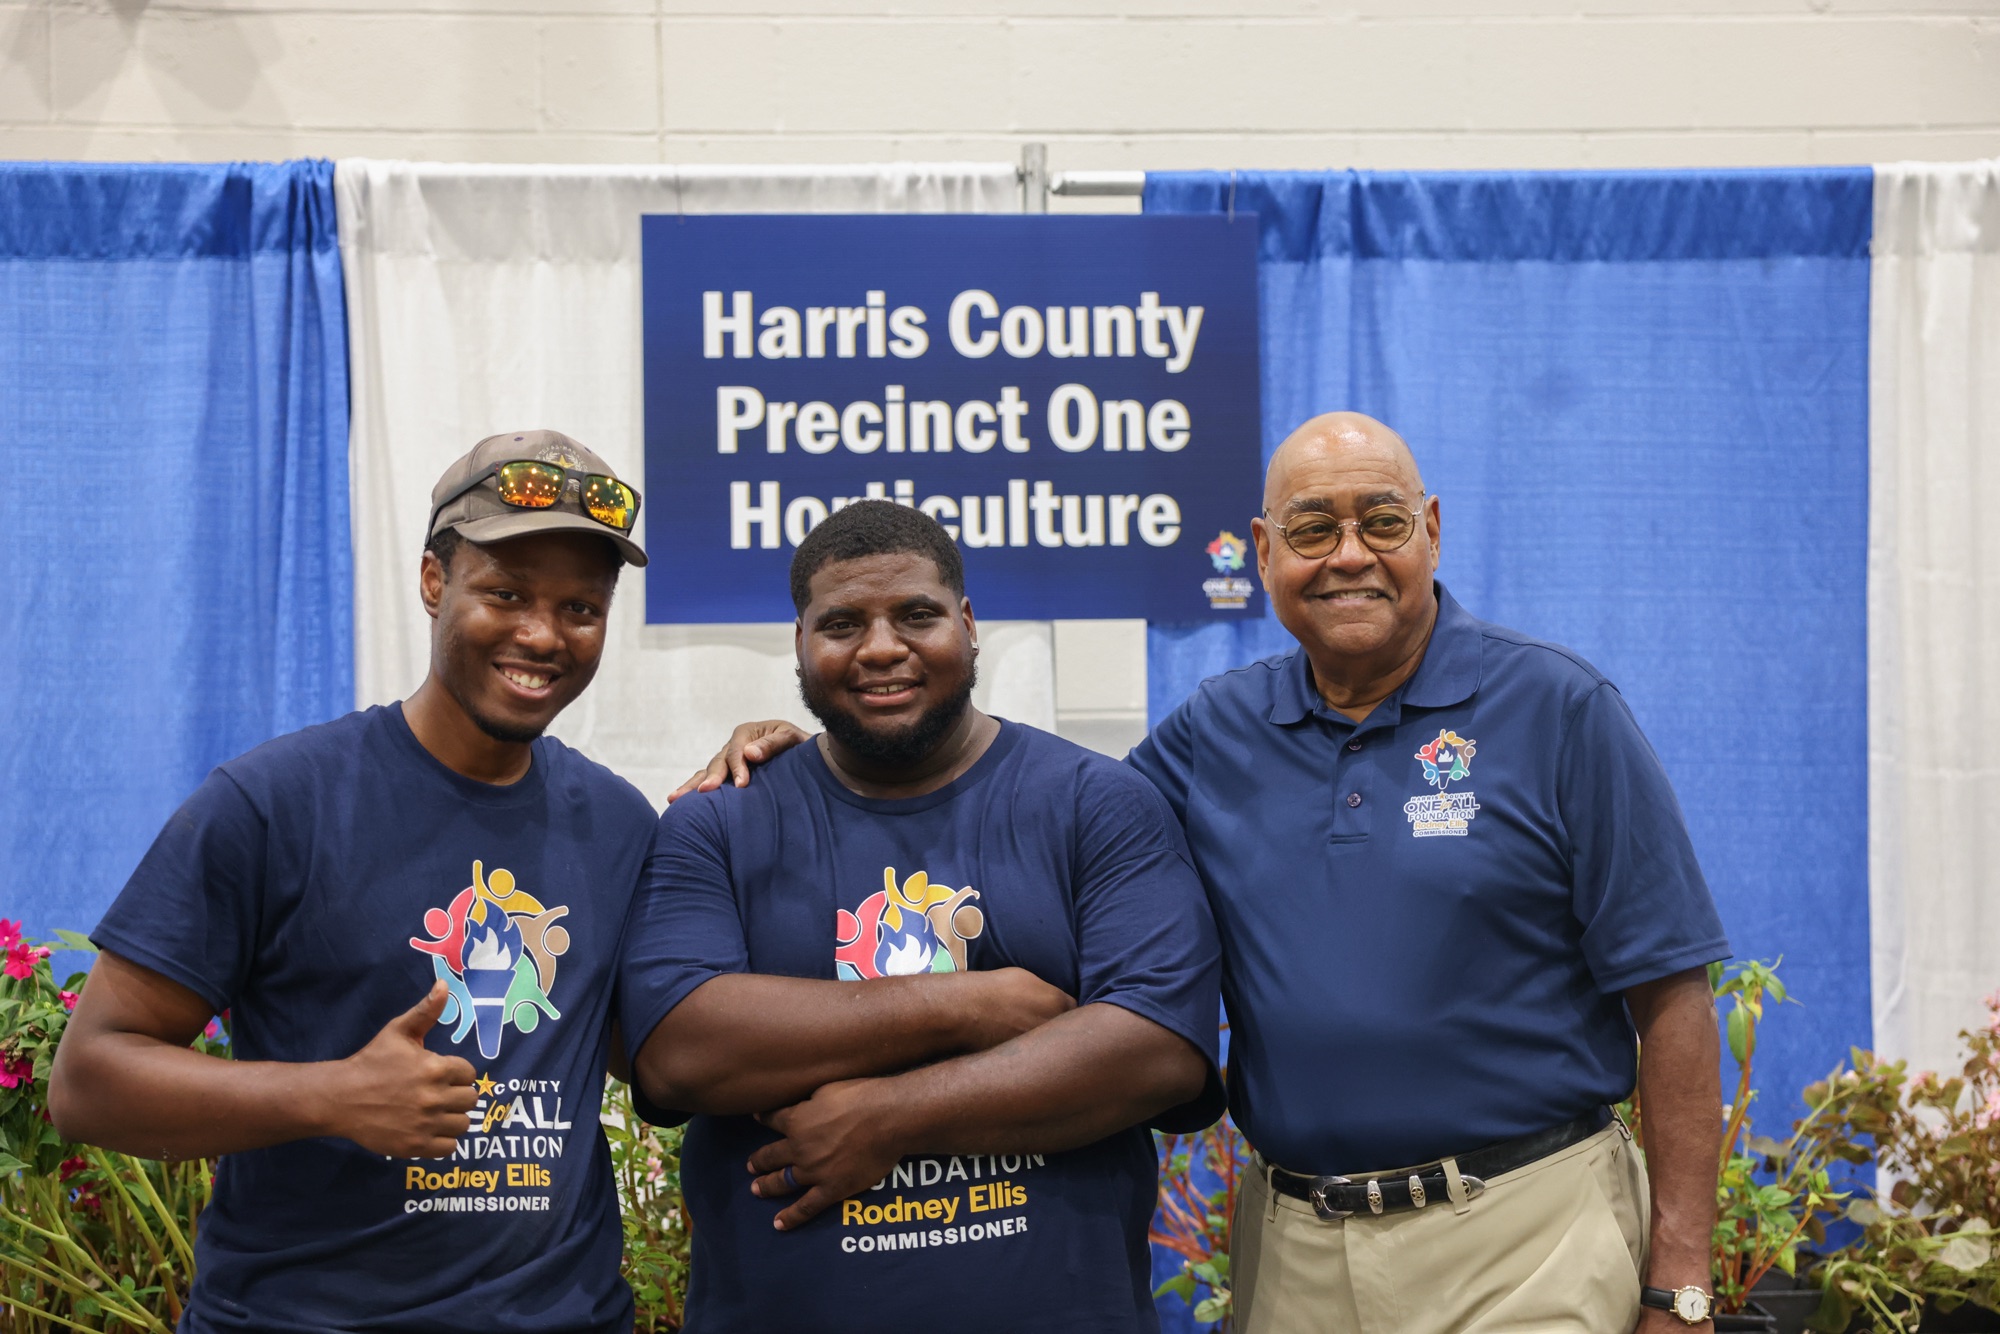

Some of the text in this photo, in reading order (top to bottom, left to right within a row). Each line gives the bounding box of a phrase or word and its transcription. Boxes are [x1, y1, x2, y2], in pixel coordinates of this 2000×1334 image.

[702, 289, 1204, 373] Harris County
[716, 383, 1191, 454] Precinct One
[730, 479, 1182, 550] Hoculture
[1404, 800, 1442, 813] ONE
[1450, 798, 1480, 810] ALL
[1408, 810, 1475, 821] FOUNDATION
[1414, 820, 1468, 830] Rodney Ellis
[1414, 829, 1467, 837] COMMISSIONER
[493, 1078, 561, 1095] COUNTY
[482, 1099, 512, 1133] for
[501, 1095, 572, 1130] ALL
[386, 1135, 564, 1161] NDATION
[405, 1163, 551, 1193] Rodney Ellis
[404, 1196, 550, 1213] COMMISSIONER
[842, 1180, 1028, 1225] Rodney Ellis
[841, 1216, 1028, 1253] COMMISSIONER
